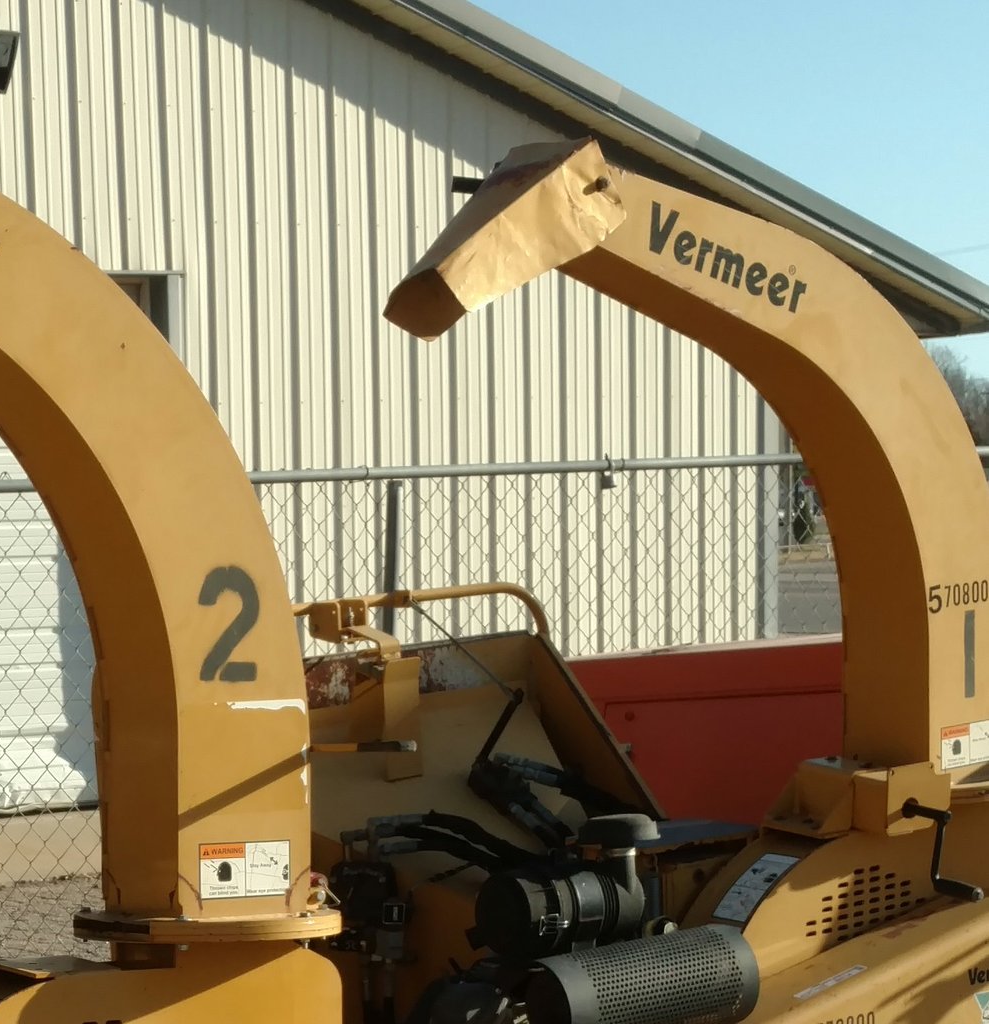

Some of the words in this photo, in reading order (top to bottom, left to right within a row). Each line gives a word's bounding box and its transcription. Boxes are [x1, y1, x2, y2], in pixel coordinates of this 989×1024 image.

[649, 200, 807, 313] Vermeer
[198, 565, 260, 682] 2
[928, 579, 989, 614] 570800
[211, 847, 244, 855] WARNING
